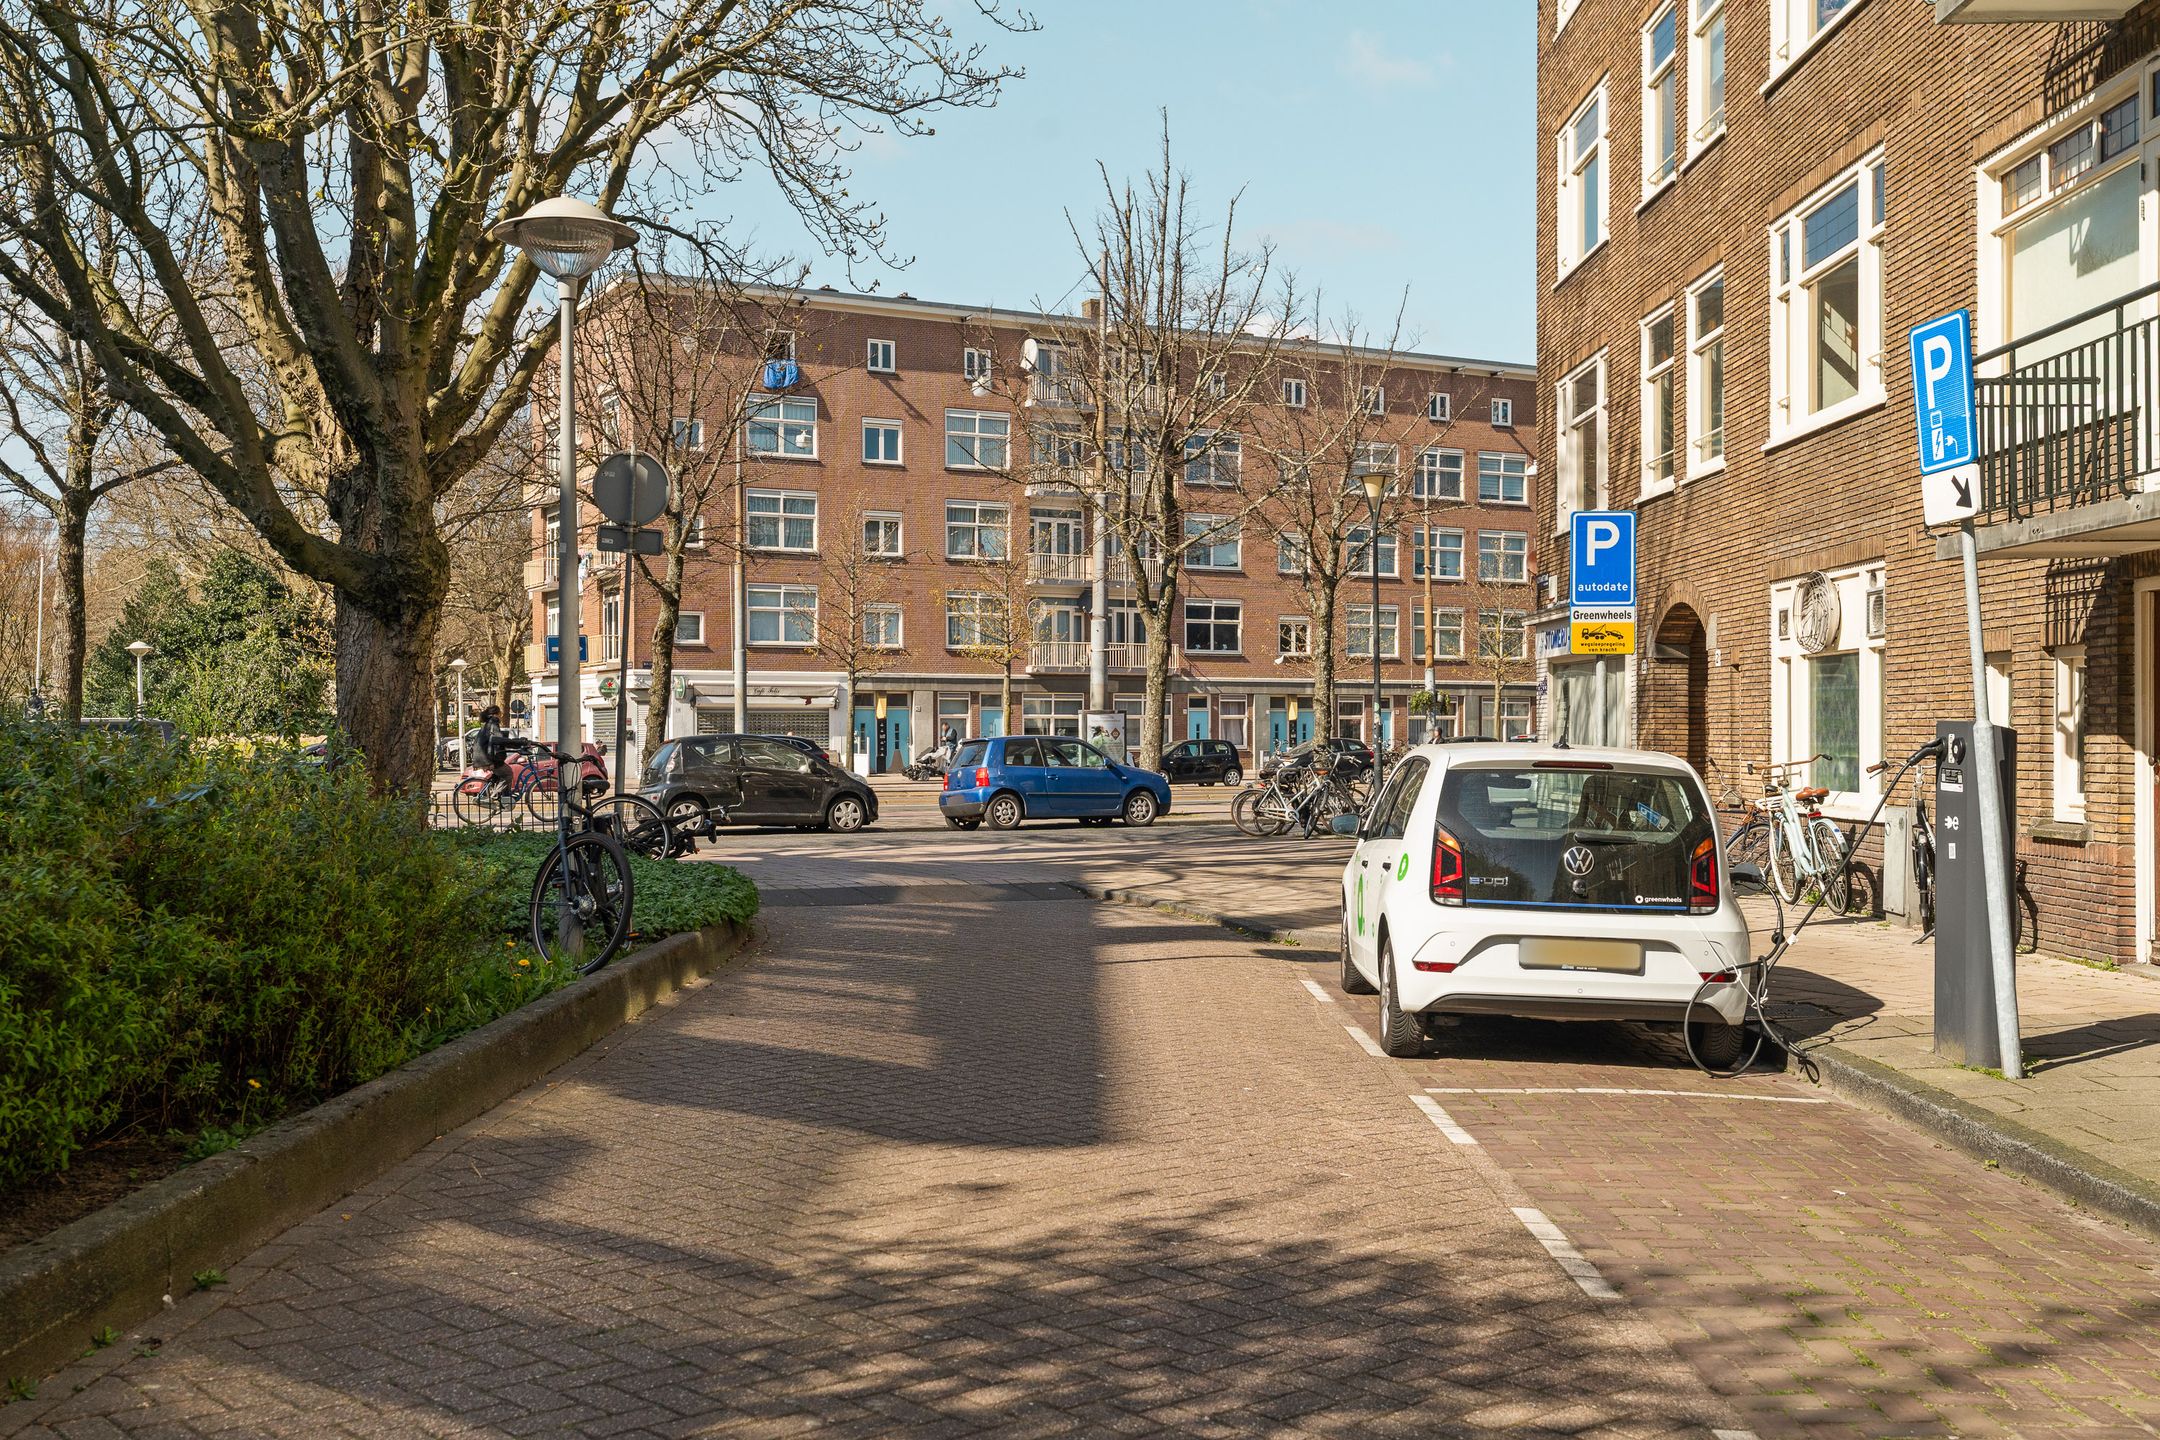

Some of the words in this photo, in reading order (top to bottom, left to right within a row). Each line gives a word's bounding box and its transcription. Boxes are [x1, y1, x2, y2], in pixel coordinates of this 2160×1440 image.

[1923, 334, 1952, 410] P
[1586, 520, 1620, 566] P
[1577, 582, 1629, 592] autodate
[1573, 610, 1632, 620] Greenwheels
[1644, 896, 1683, 904] greenwheels
